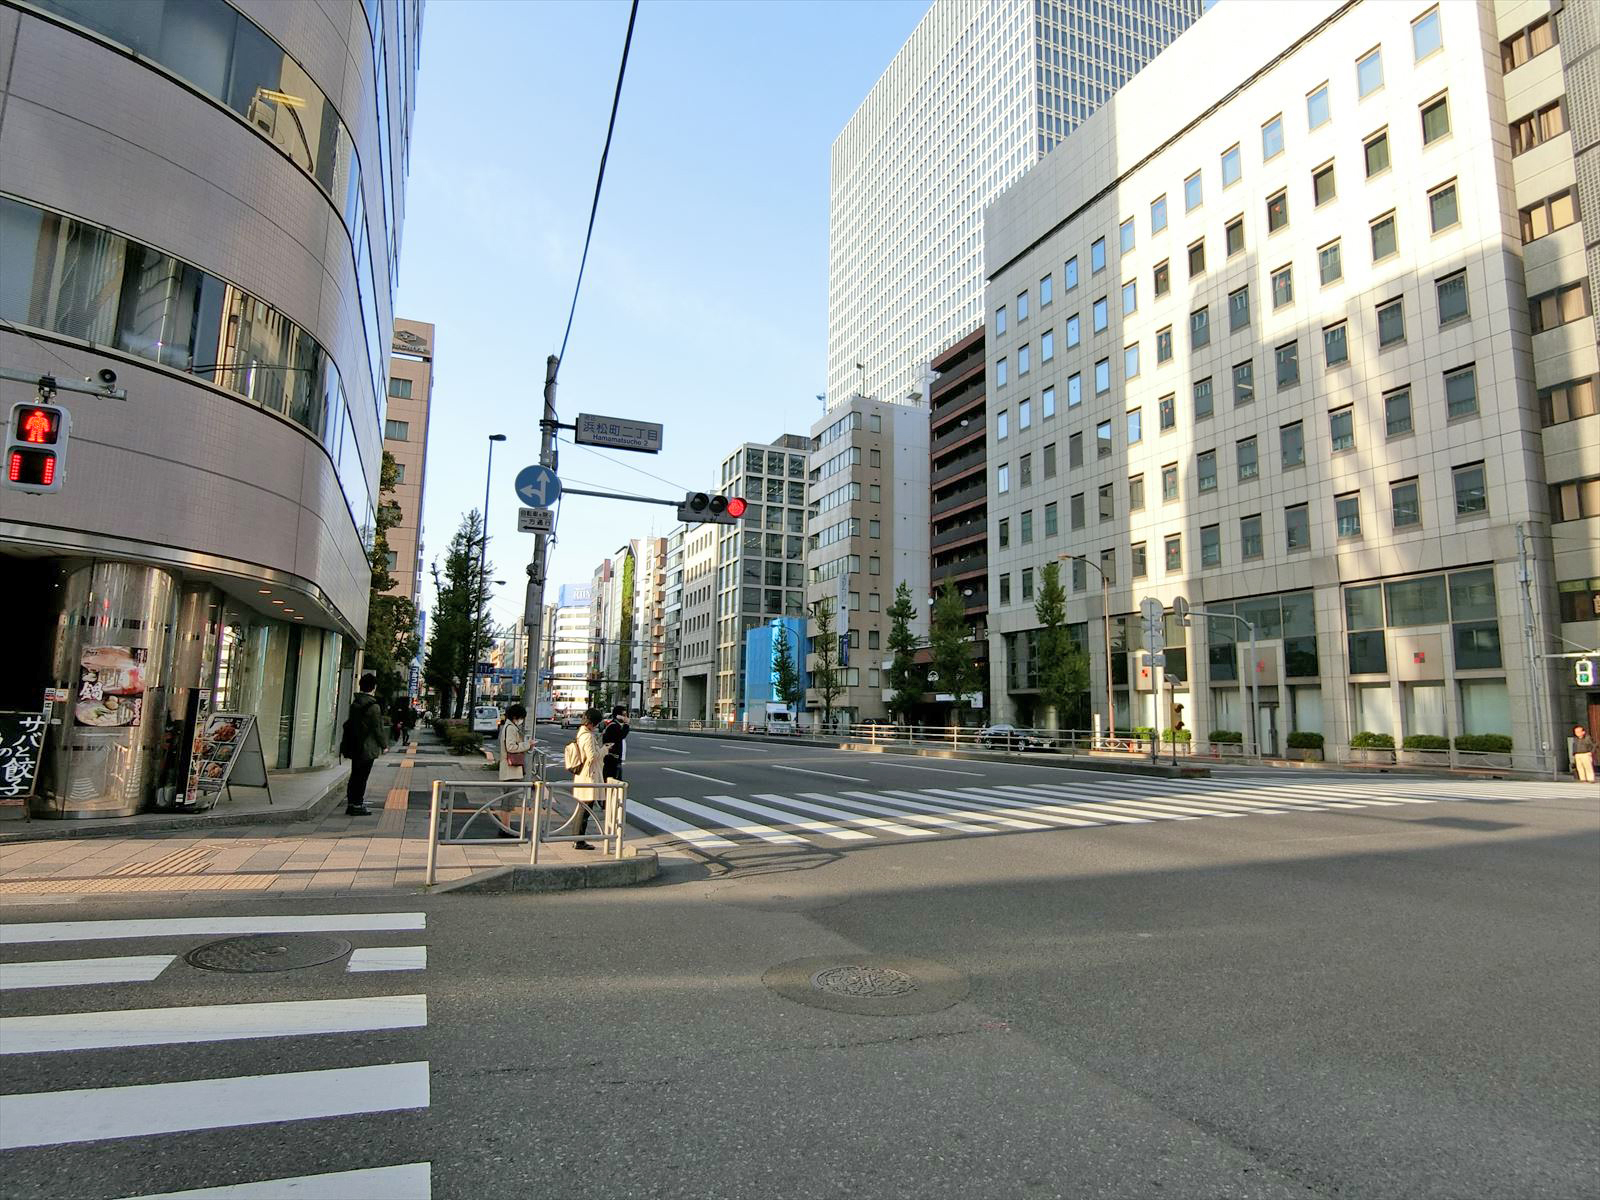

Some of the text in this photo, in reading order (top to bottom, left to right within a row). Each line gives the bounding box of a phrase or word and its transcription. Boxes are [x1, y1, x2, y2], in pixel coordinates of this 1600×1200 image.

[583, 420, 658, 441] 浜松町二丁目
[592, 433, 642, 446] Hamamatsucho
[0, 715, 46, 796] サバと餃子
